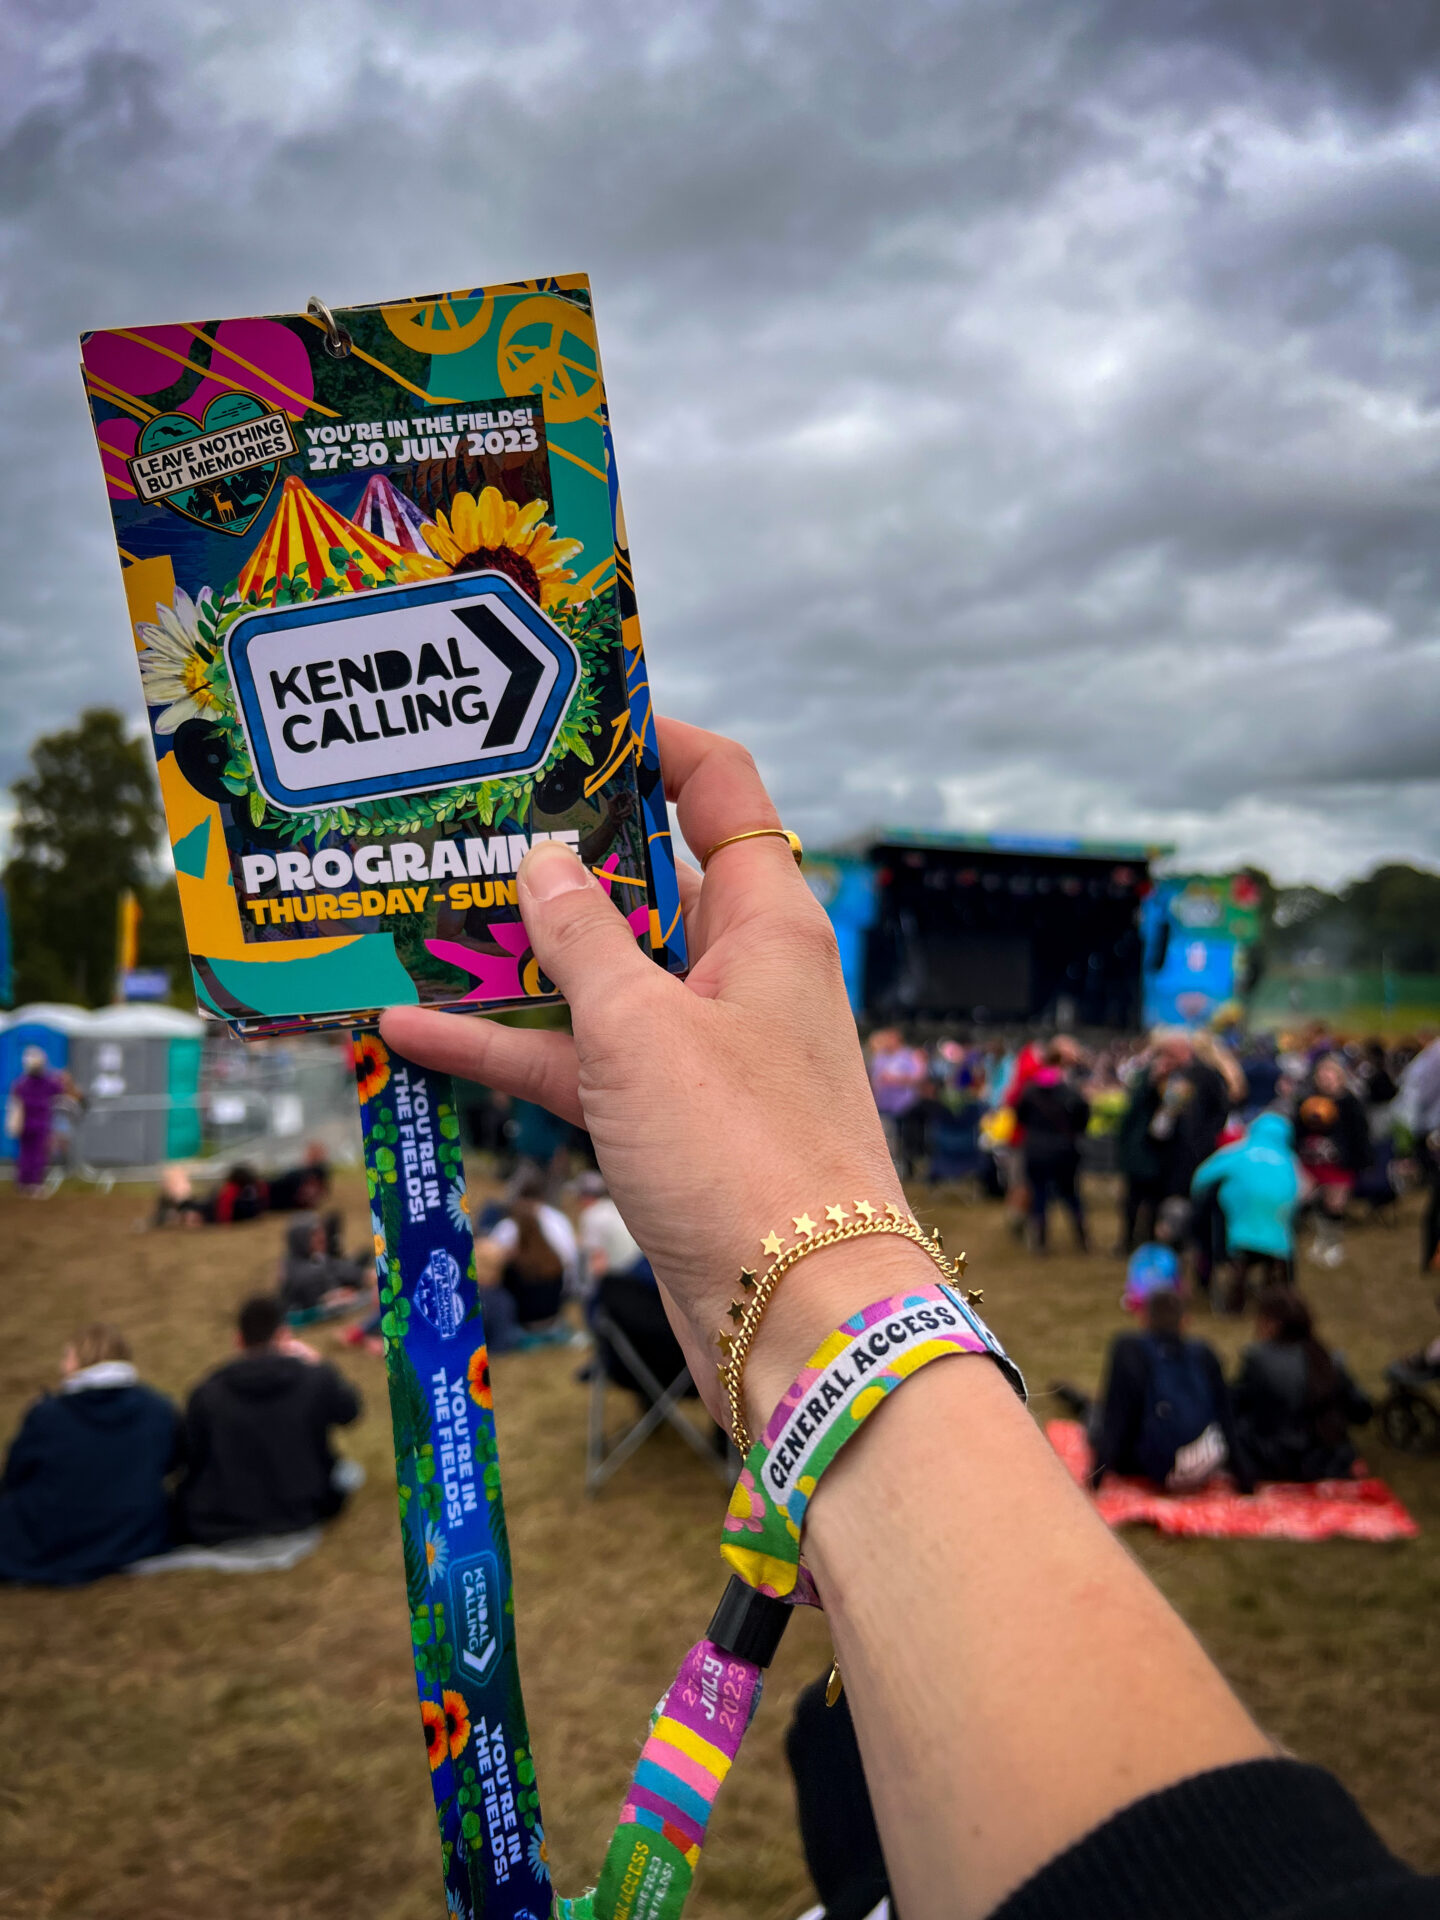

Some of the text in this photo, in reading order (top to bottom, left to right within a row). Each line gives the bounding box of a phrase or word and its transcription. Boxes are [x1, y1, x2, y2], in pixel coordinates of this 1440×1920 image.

[137, 418, 284, 478] LEAVE NOTHING
[305, 408, 534, 445] YOU'RE IN THE FIELDS!
[308, 428, 539, 471] 27-30 JULY 2023
[146, 437, 287, 493] BUT MEMORIES
[269, 637, 480, 709] KENDAL
[281, 685, 489, 753] CALLING
[246, 885, 428, 925] THURSDAY
[448, 879, 519, 911] SUN
[394, 1067, 426, 1224] THE FIELDS!
[412, 1077, 441, 1210] YOU'RE IN
[769, 1305, 957, 1489] GENERAL ACCESS
[432, 1367, 464, 1528] THE FIELDS!
[450, 1377, 478, 1513] YOU'RE IN
[462, 1570, 480, 1652] CALLING
[473, 1566, 490, 1645] KENDAL
[700, 1654, 723, 1720] JULY
[719, 1662, 747, 1734] 2023
[473, 1715, 510, 1886] THE FIELDS!
[489, 1722, 522, 1865] YOU'RE IN
